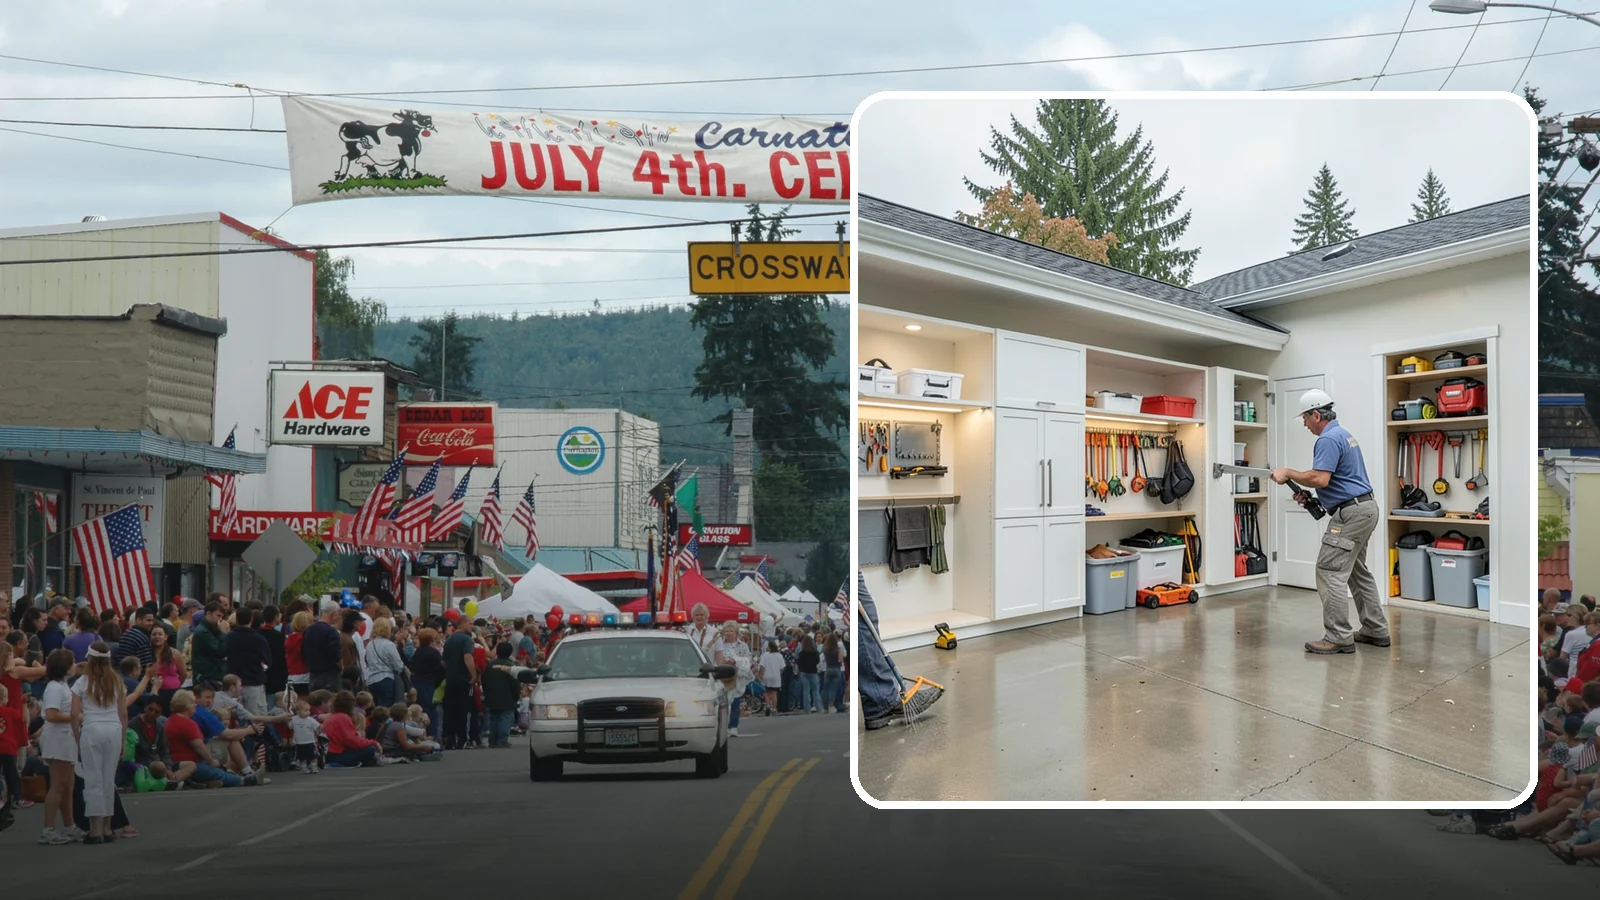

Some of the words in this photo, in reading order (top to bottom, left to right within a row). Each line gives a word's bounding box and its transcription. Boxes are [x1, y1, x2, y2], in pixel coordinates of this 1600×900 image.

[481, 141, 605, 192] JULY
[632, 150, 746, 198] 4th.
[696, 254, 850, 280] CROSSWA
[283, 380, 373, 420] ACE
[283, 421, 371, 436] Hardware
[416, 428, 477, 447] Coca-Cola
[353, 467, 384, 480] Simpl
[95, 485, 124, 495] Vincent
[126, 486, 135, 495] de
[137, 486, 155, 495] Paul
[688, 526, 741, 535] CRNATION
[699, 535, 730, 543] GLASS
